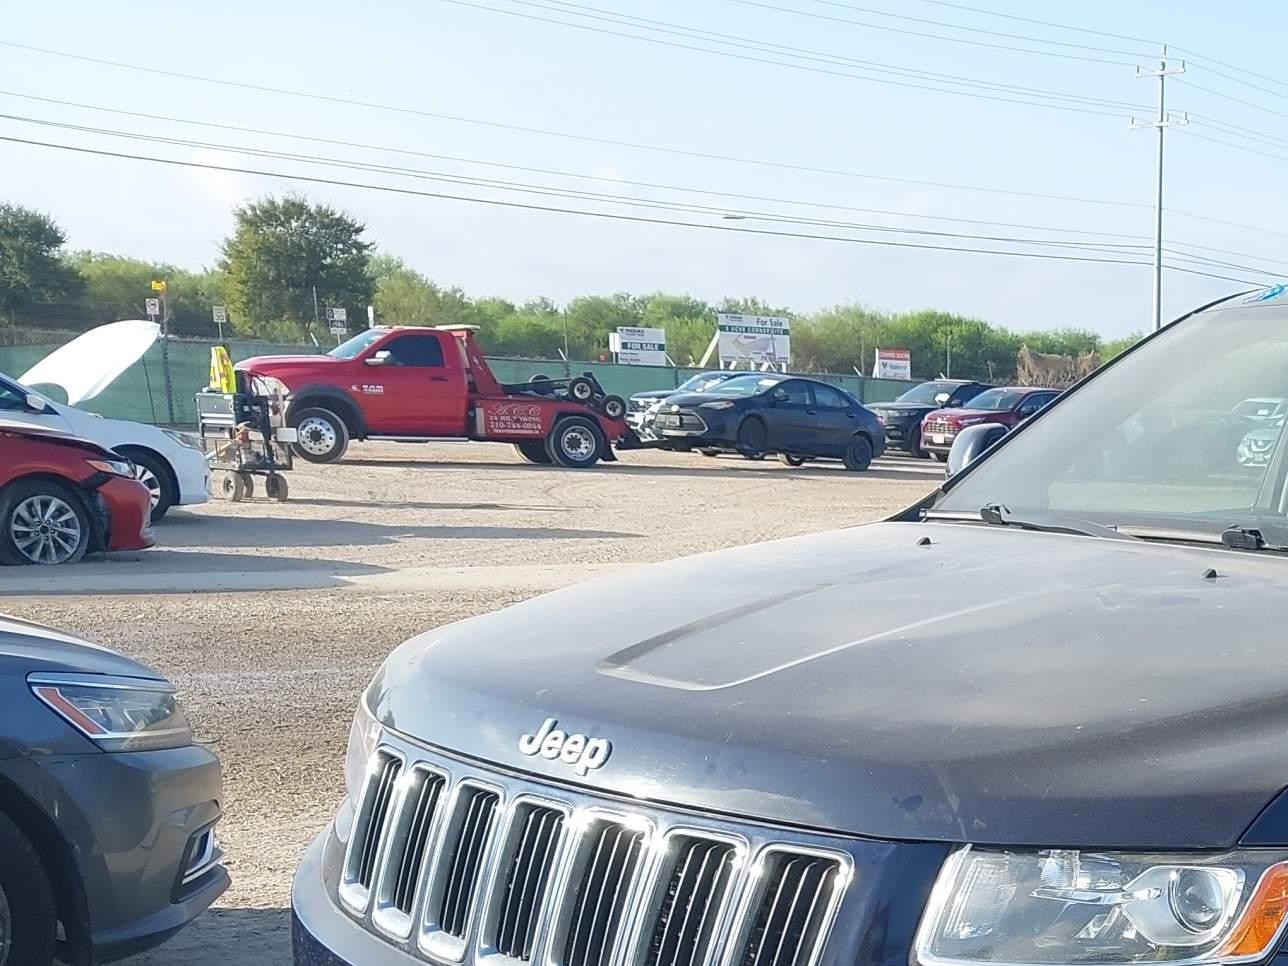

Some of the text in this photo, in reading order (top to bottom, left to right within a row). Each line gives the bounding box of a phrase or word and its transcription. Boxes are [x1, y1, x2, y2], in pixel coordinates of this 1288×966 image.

[756, 317, 783, 328] For Sale
[627, 342, 659, 351] FOR SALE
[519, 718, 612, 777] Jeep
